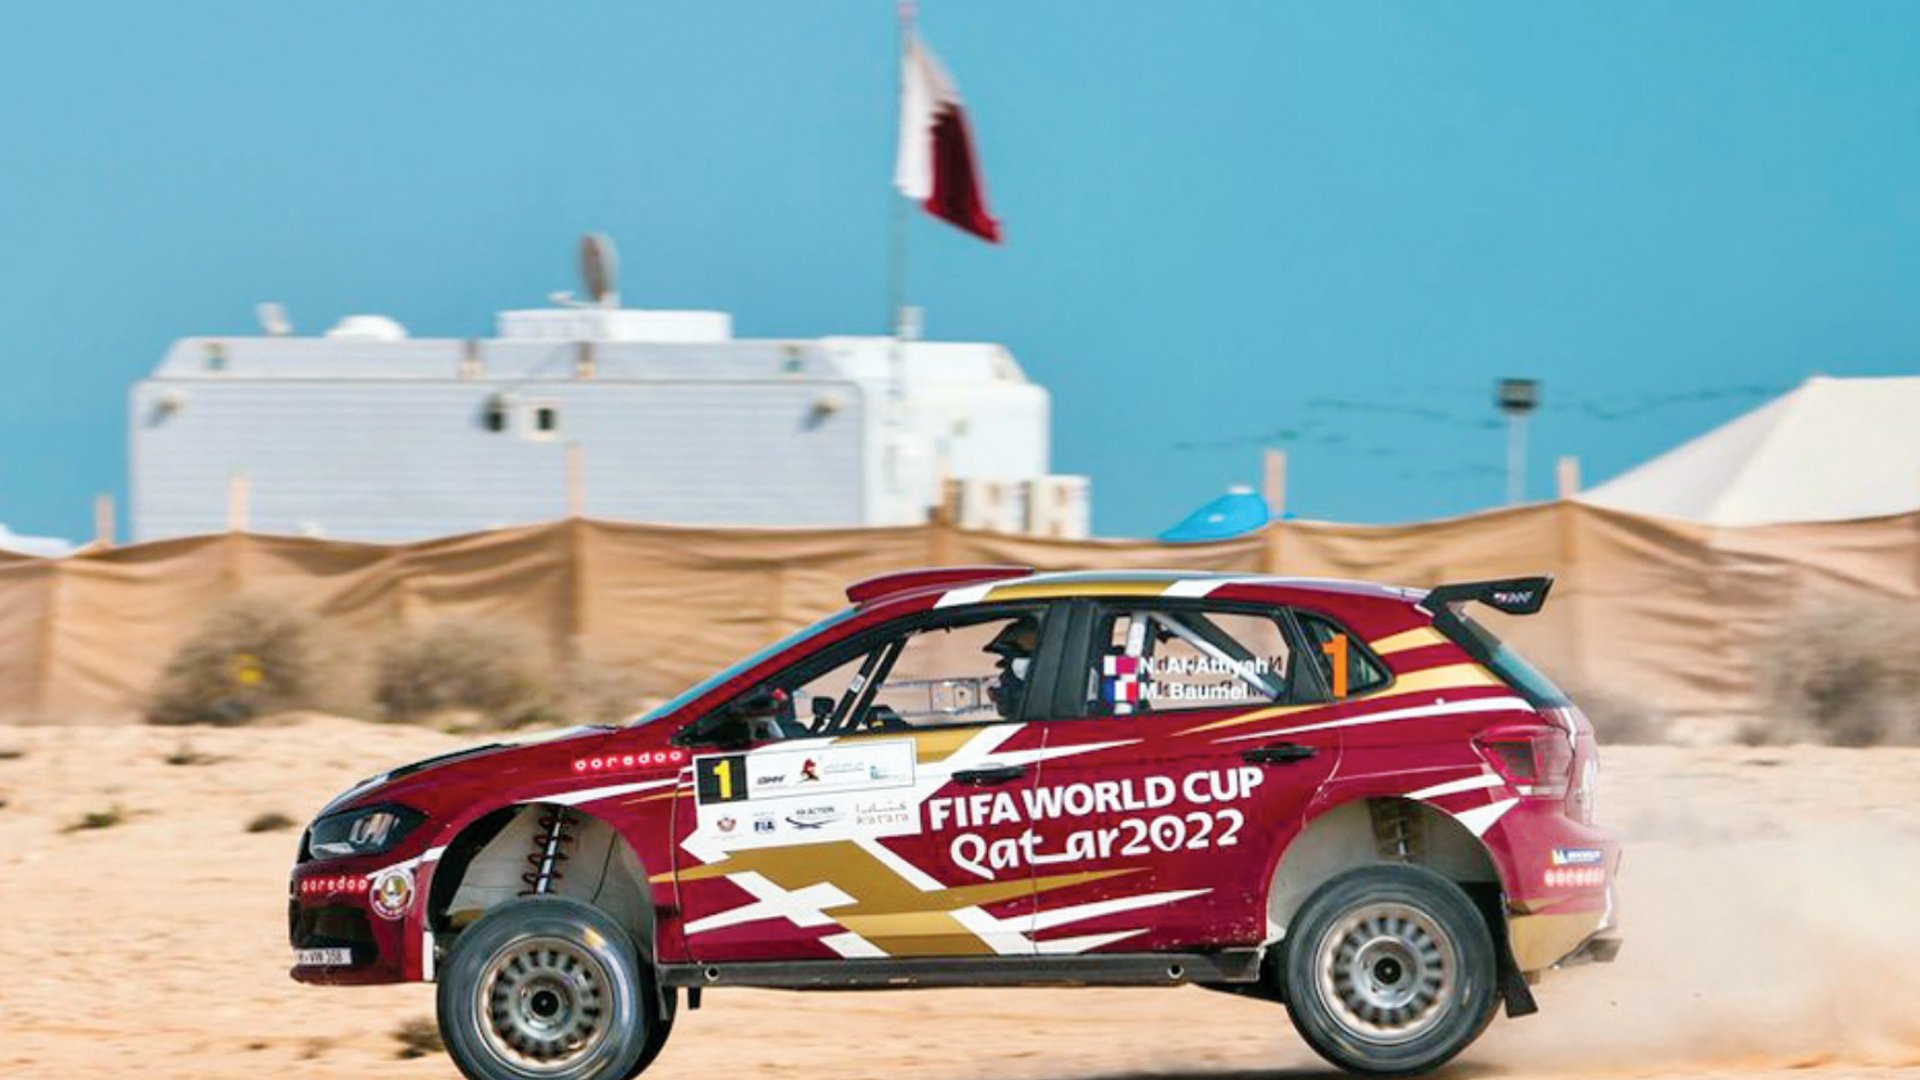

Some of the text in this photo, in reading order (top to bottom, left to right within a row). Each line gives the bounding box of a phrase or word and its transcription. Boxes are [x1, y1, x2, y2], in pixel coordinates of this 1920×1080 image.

[1140, 657, 1160, 674] N.
[1168, 656, 1269, 678] Al-Attiyah
[1321, 633, 1347, 697] 1
[1140, 682, 1161, 699] M.
[1169, 681, 1248, 700] Baumel
[574, 751, 682, 772] ooredoo
[713, 759, 732, 799] 1
[929, 766, 1264, 831] FIFA WORLD CUP
[753, 820, 776, 832] FIA
[301, 875, 368, 892] ooredoo
